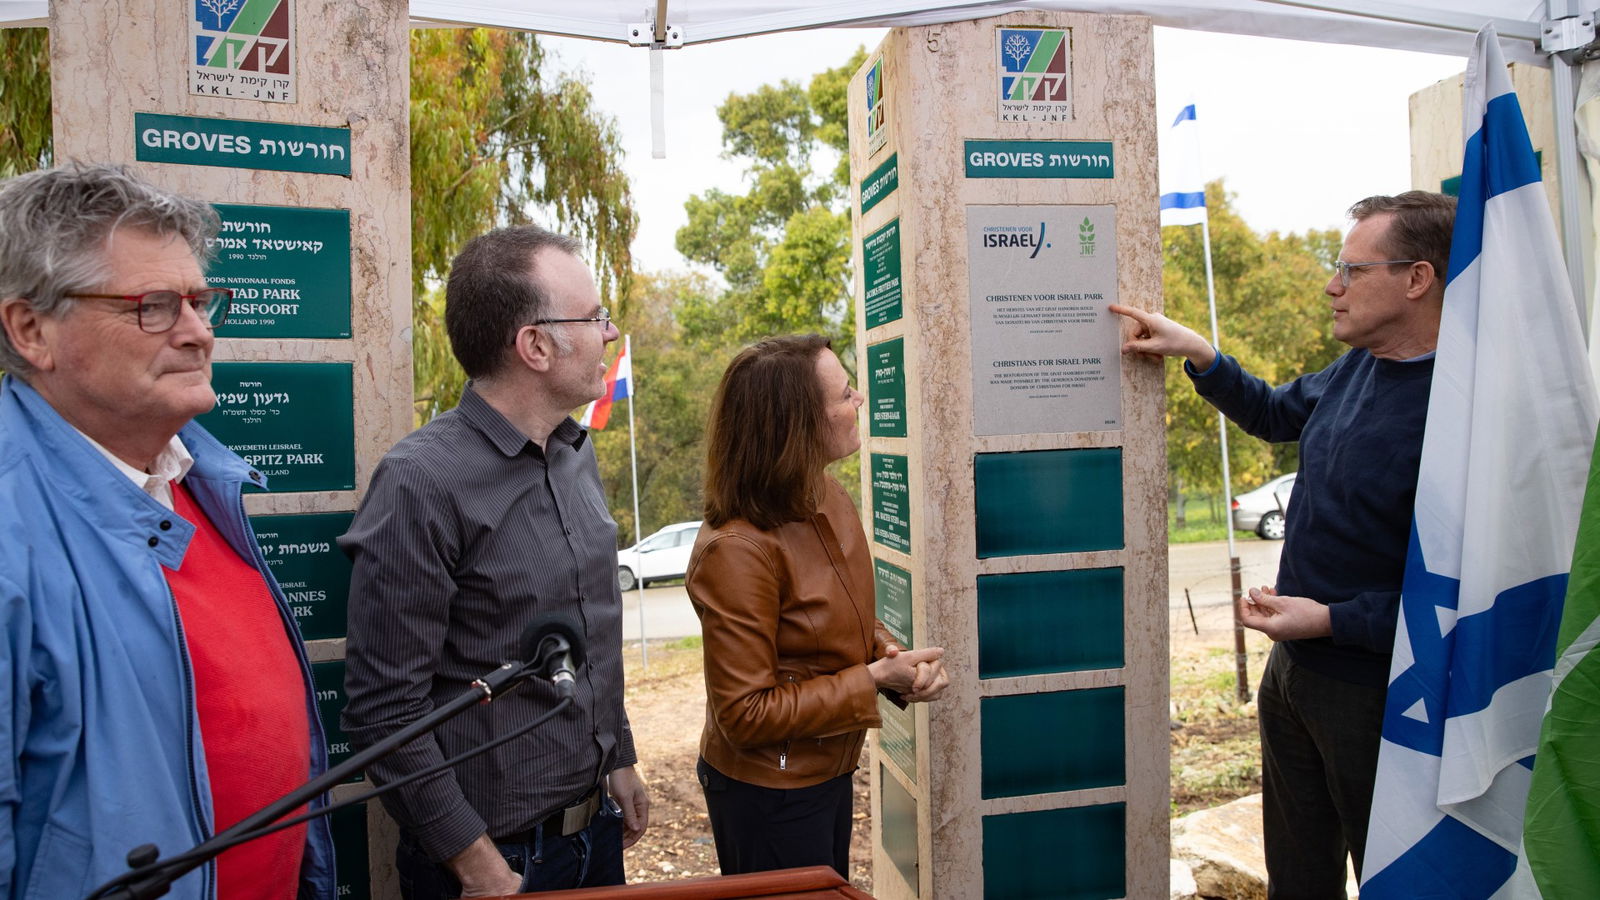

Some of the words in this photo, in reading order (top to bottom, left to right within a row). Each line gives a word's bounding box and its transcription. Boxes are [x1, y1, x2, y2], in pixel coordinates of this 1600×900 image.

[196, 70, 234, 83] לישראל
[241, 76, 267, 88] קימת
[274, 80, 289, 89] קרן
[196, 84, 233, 96] KKL
[253, 89, 289, 100] JNF
[1003, 103, 1029, 112] לישראל
[1033, 105, 1051, 113] קימת
[1055, 105, 1067, 113] קרן
[142, 128, 251, 155] GROVES
[259, 138, 345, 161] חורשות
[969, 152, 1044, 167] GROVES
[1049, 154, 1110, 168] חורשות
[861, 179, 880, 204] GROVES
[222, 220, 271, 233] חורשת
[205, 236, 247, 249] אמרס
[983, 234, 1036, 248] ISRAEL
[1080, 245, 1095, 255] JNF
[230, 288, 259, 299] TAD
[262, 288, 301, 300] PARK
[985, 294, 1032, 302] CHRISTENEN
[1057, 293, 1082, 301] ISRAEL
[228, 303, 300, 315] RSFOORT
[992, 360, 1037, 368] CHRISTIANS
[1038, 359, 1054, 367] FOR
[1055, 358, 1081, 366] ISRAEL
[1082, 357, 1102, 365] PARK
[253, 392, 290, 407] גדעון
[243, 454, 283, 466] SPITZ
[286, 453, 324, 465] PARK
[278, 542, 330, 555] משפחת
[278, 581, 307, 589] EISRAEL
[288, 590, 327, 602] NNES
[293, 605, 314, 617] RK
[316, 690, 338, 701] חור
[327, 742, 351, 755] RK
